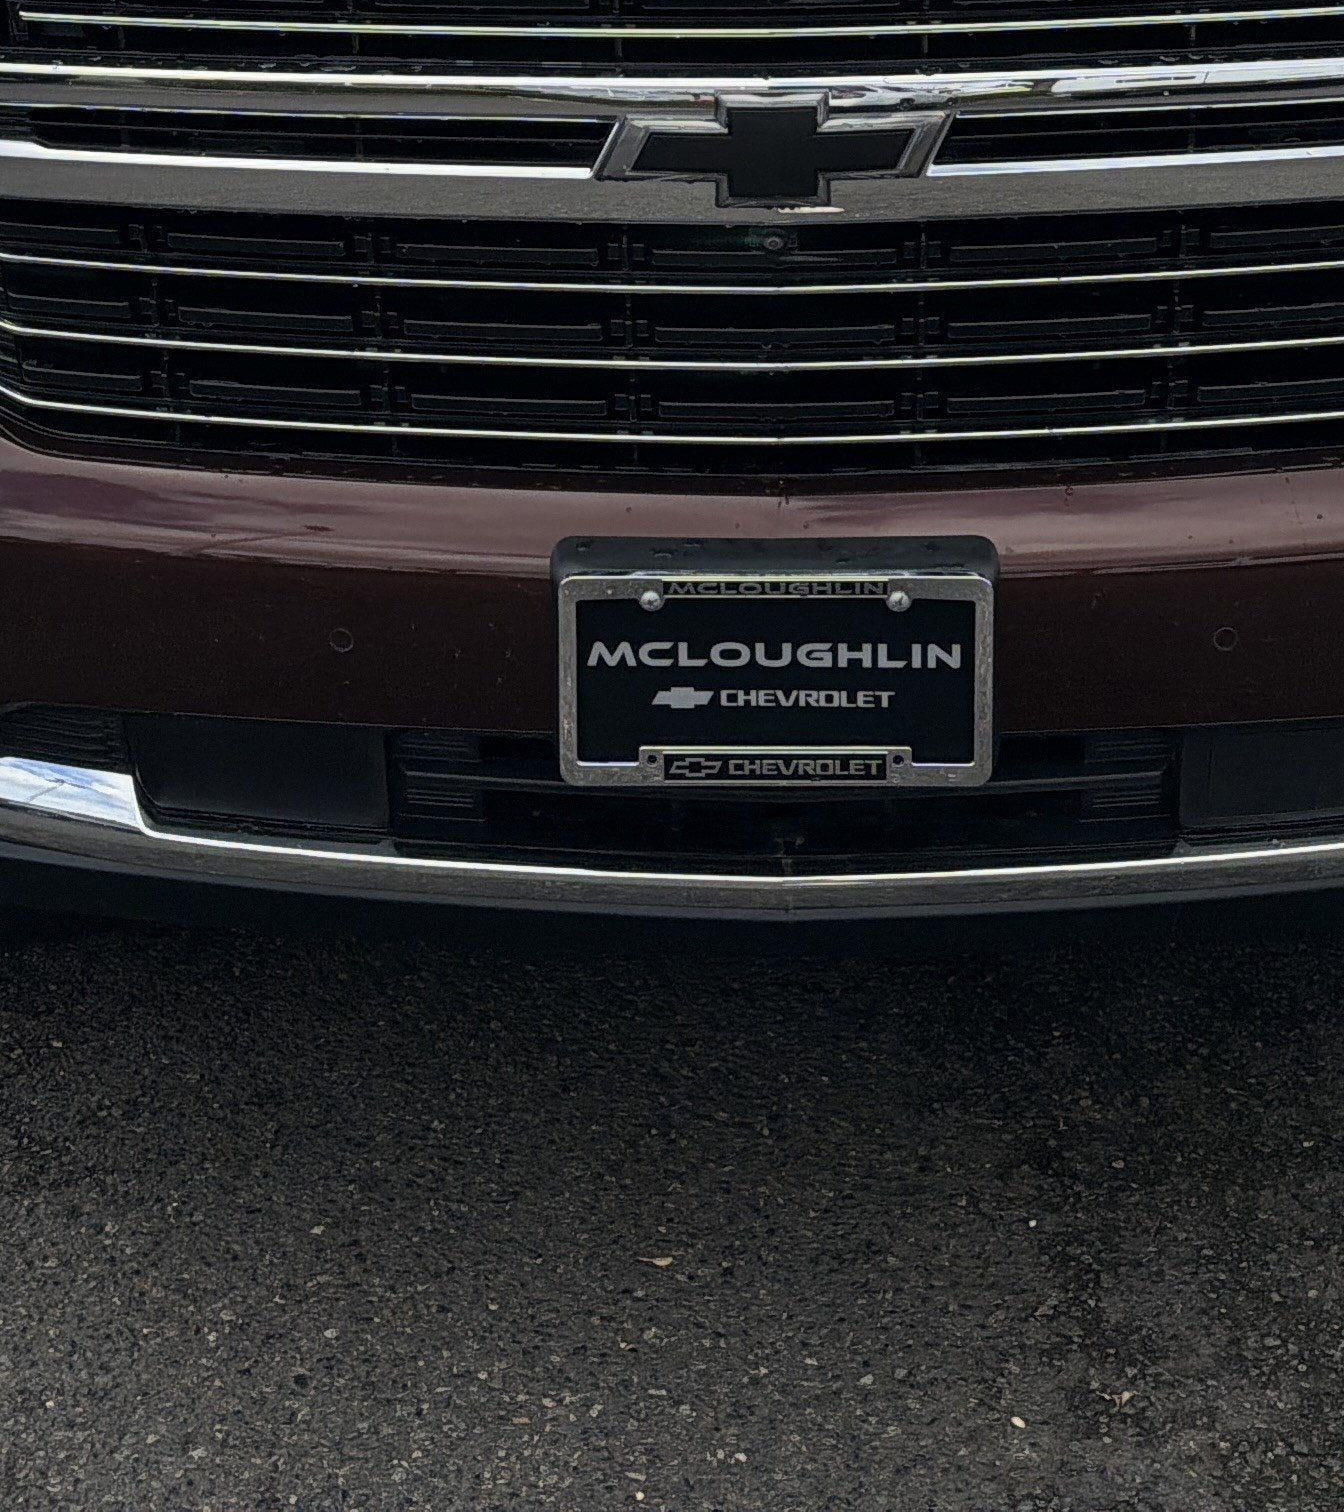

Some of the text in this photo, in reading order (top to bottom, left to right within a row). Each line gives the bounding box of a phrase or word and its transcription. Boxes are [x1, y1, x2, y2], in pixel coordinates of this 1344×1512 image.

[668, 581, 885, 596] MCLOUGHLIN
[587, 641, 962, 670] MCLOUGHLIN
[719, 689, 896, 708] CHEVROLET
[728, 759, 883, 777] CHEVROLET
